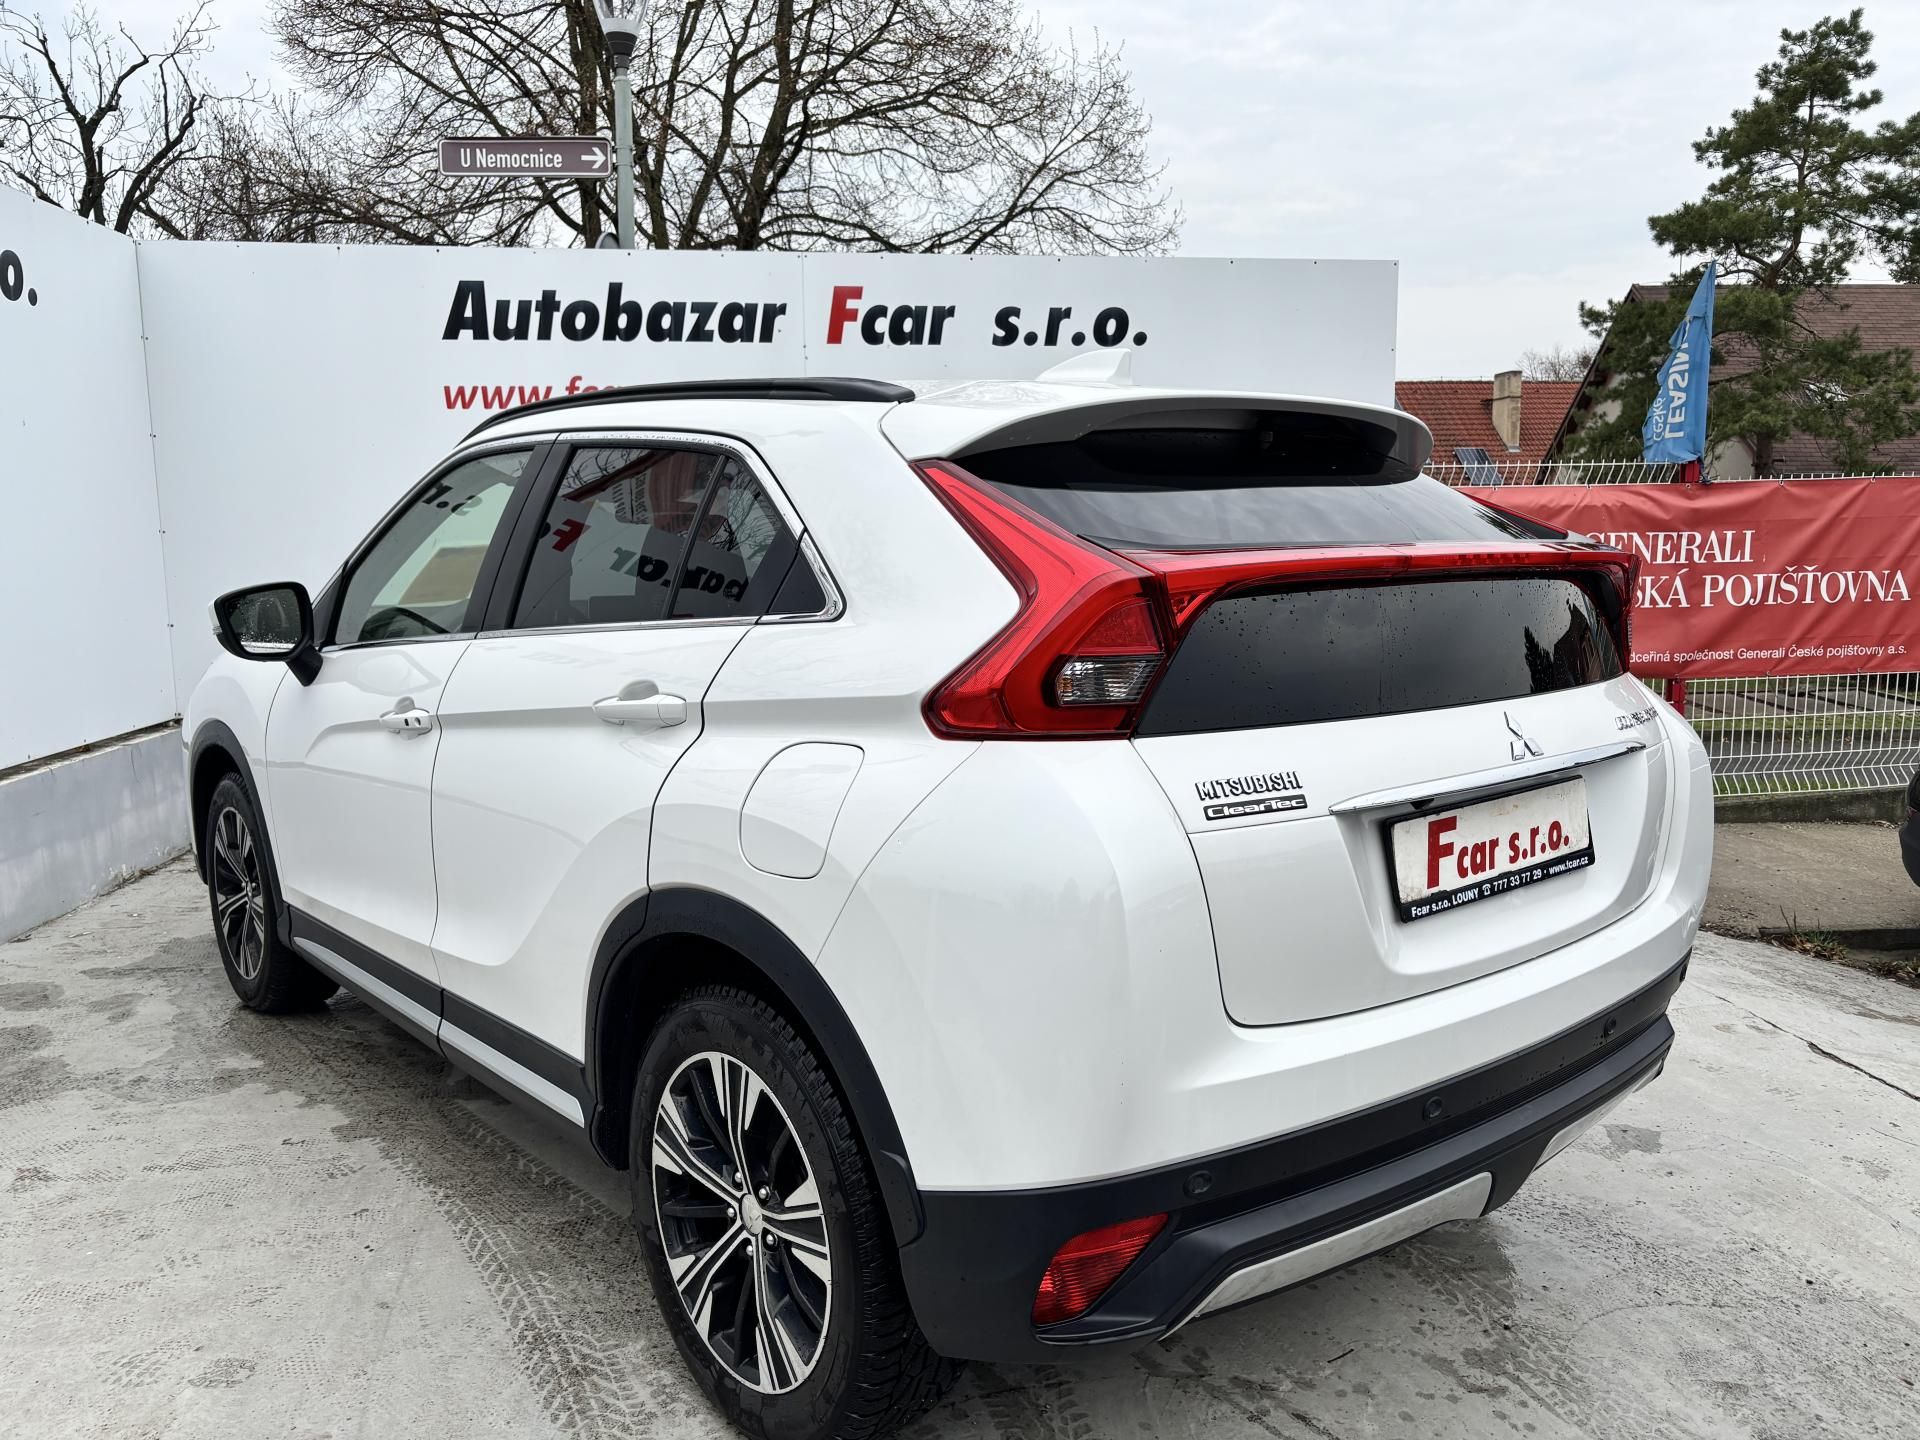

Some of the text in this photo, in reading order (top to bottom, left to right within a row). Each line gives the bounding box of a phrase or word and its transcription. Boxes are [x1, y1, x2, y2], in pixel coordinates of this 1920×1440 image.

[460, 148, 563, 169] U Nemocnice
[441, 280, 1148, 347] Autobazar Fcar s.r.o.
[1701, 564, 1912, 608] POJIŠŤOVNA
[1673, 649, 1735, 664] společnost
[1737, 647, 1786, 660] Generali
[1788, 644, 1824, 658] České
[1826, 644, 1885, 659] pojišťovny
[1887, 645, 1907, 655] a.s.
[1195, 770, 1304, 801] MITSUBISHI
[1206, 798, 1306, 818] ClearTec
[1427, 815, 1570, 889] Fcar s.r.o.
[1411, 856, 1589, 918] Fcar s.r.o. LOUNY 777 33 77 29 www.fcar.cz
